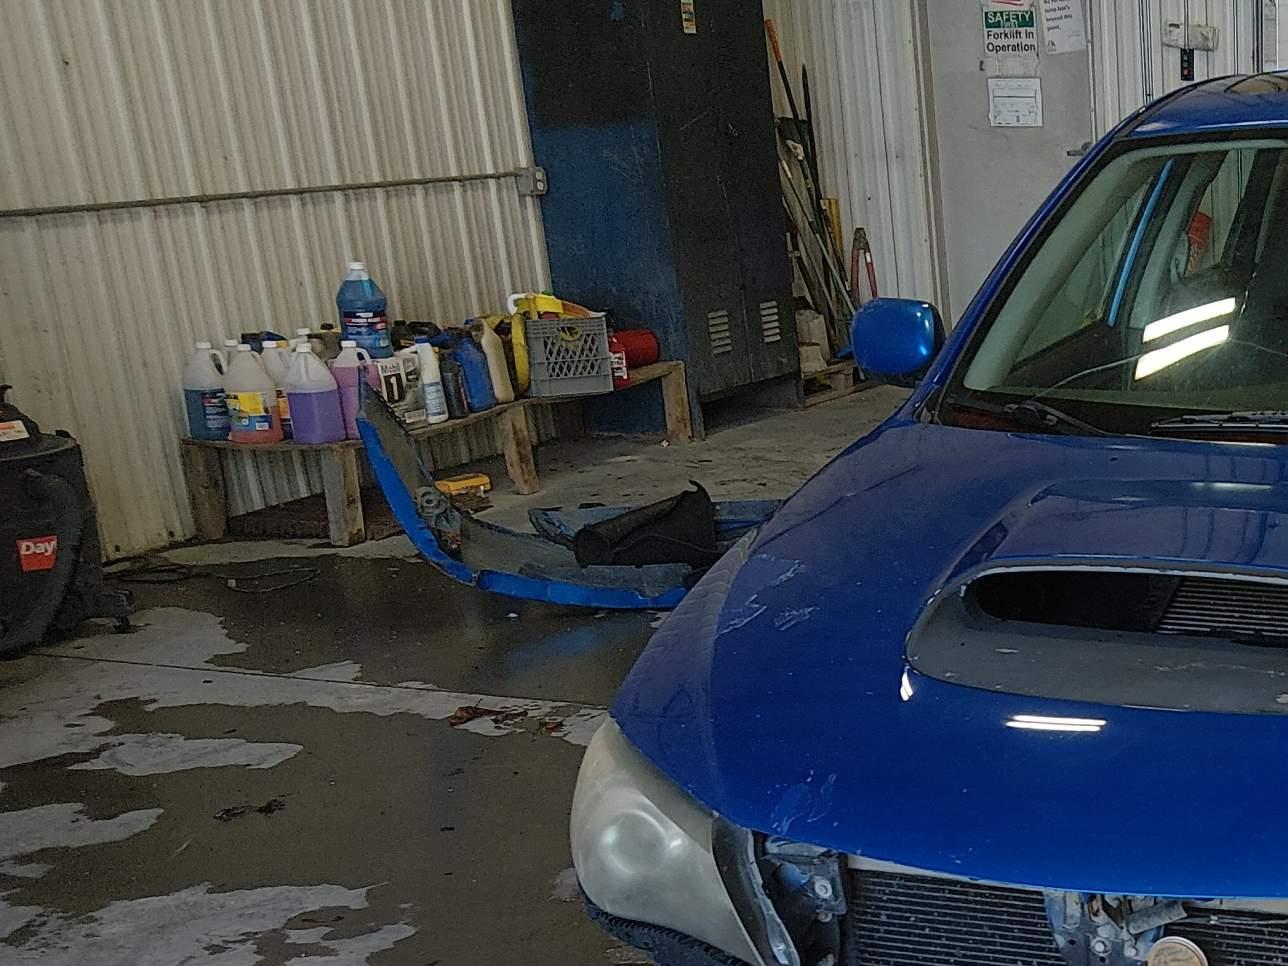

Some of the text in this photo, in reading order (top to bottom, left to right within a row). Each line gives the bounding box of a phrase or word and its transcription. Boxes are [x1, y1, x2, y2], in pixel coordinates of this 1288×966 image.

[987, 11, 1032, 23] SAFETY
[986, 30, 1035, 40] Forklift In
[986, 41, 1036, 54] Operation
